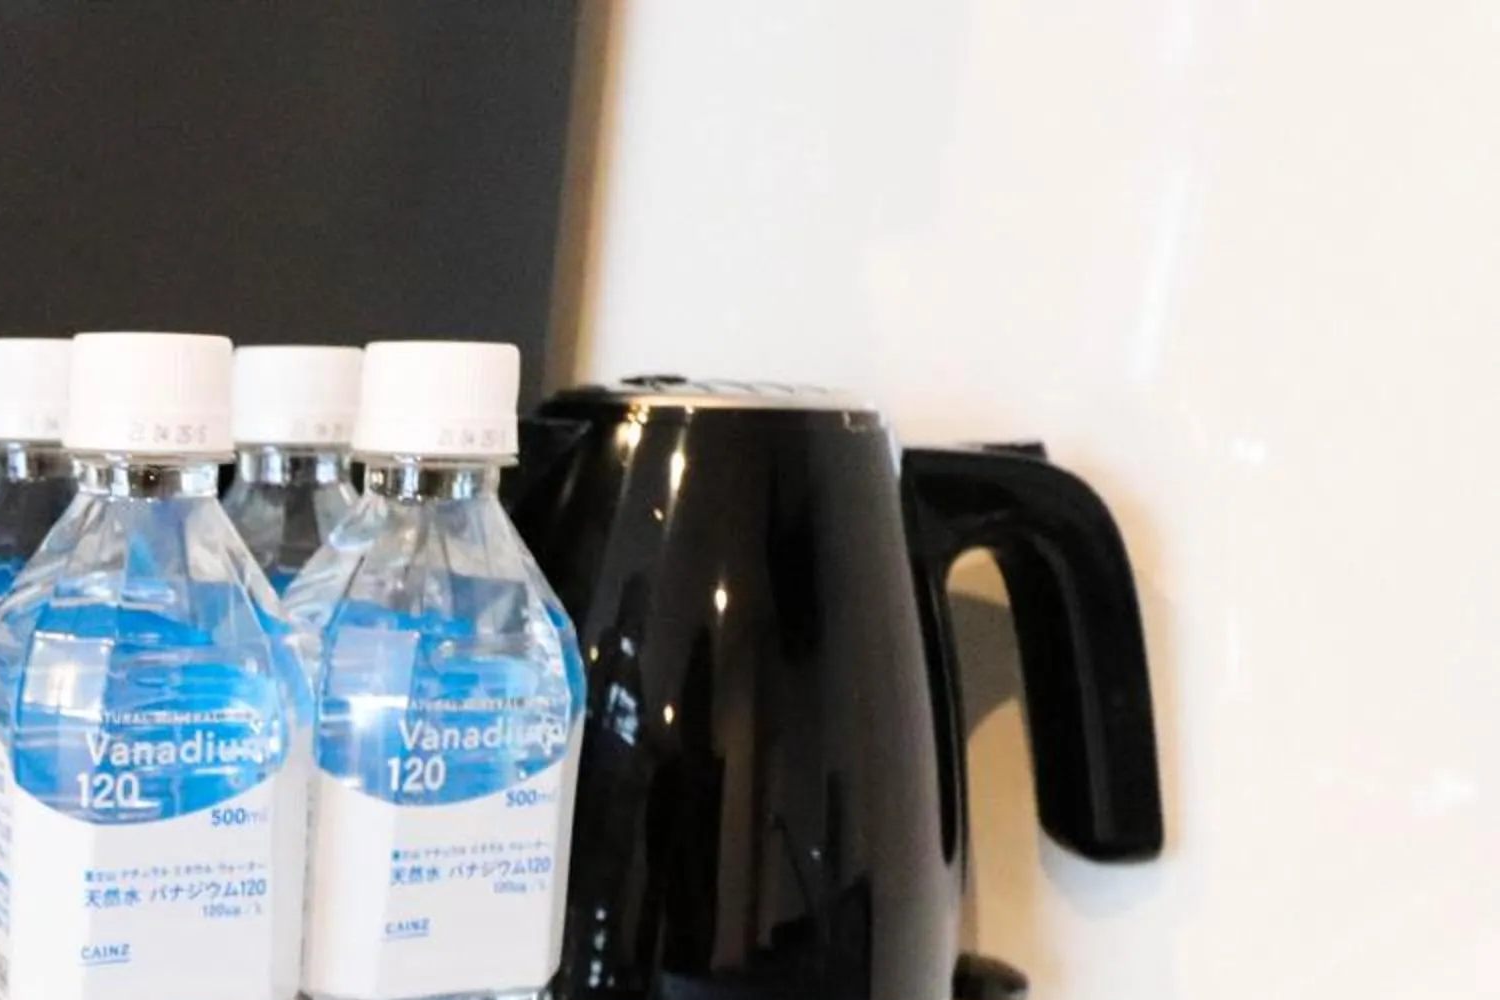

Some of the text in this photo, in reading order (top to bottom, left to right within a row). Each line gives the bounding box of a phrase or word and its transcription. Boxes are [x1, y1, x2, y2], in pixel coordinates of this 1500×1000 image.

[388, 755, 446, 793] 120
[76, 772, 139, 809] 120
[84, 887, 142, 909] 天然水
[80, 943, 131, 960] CAINZ
